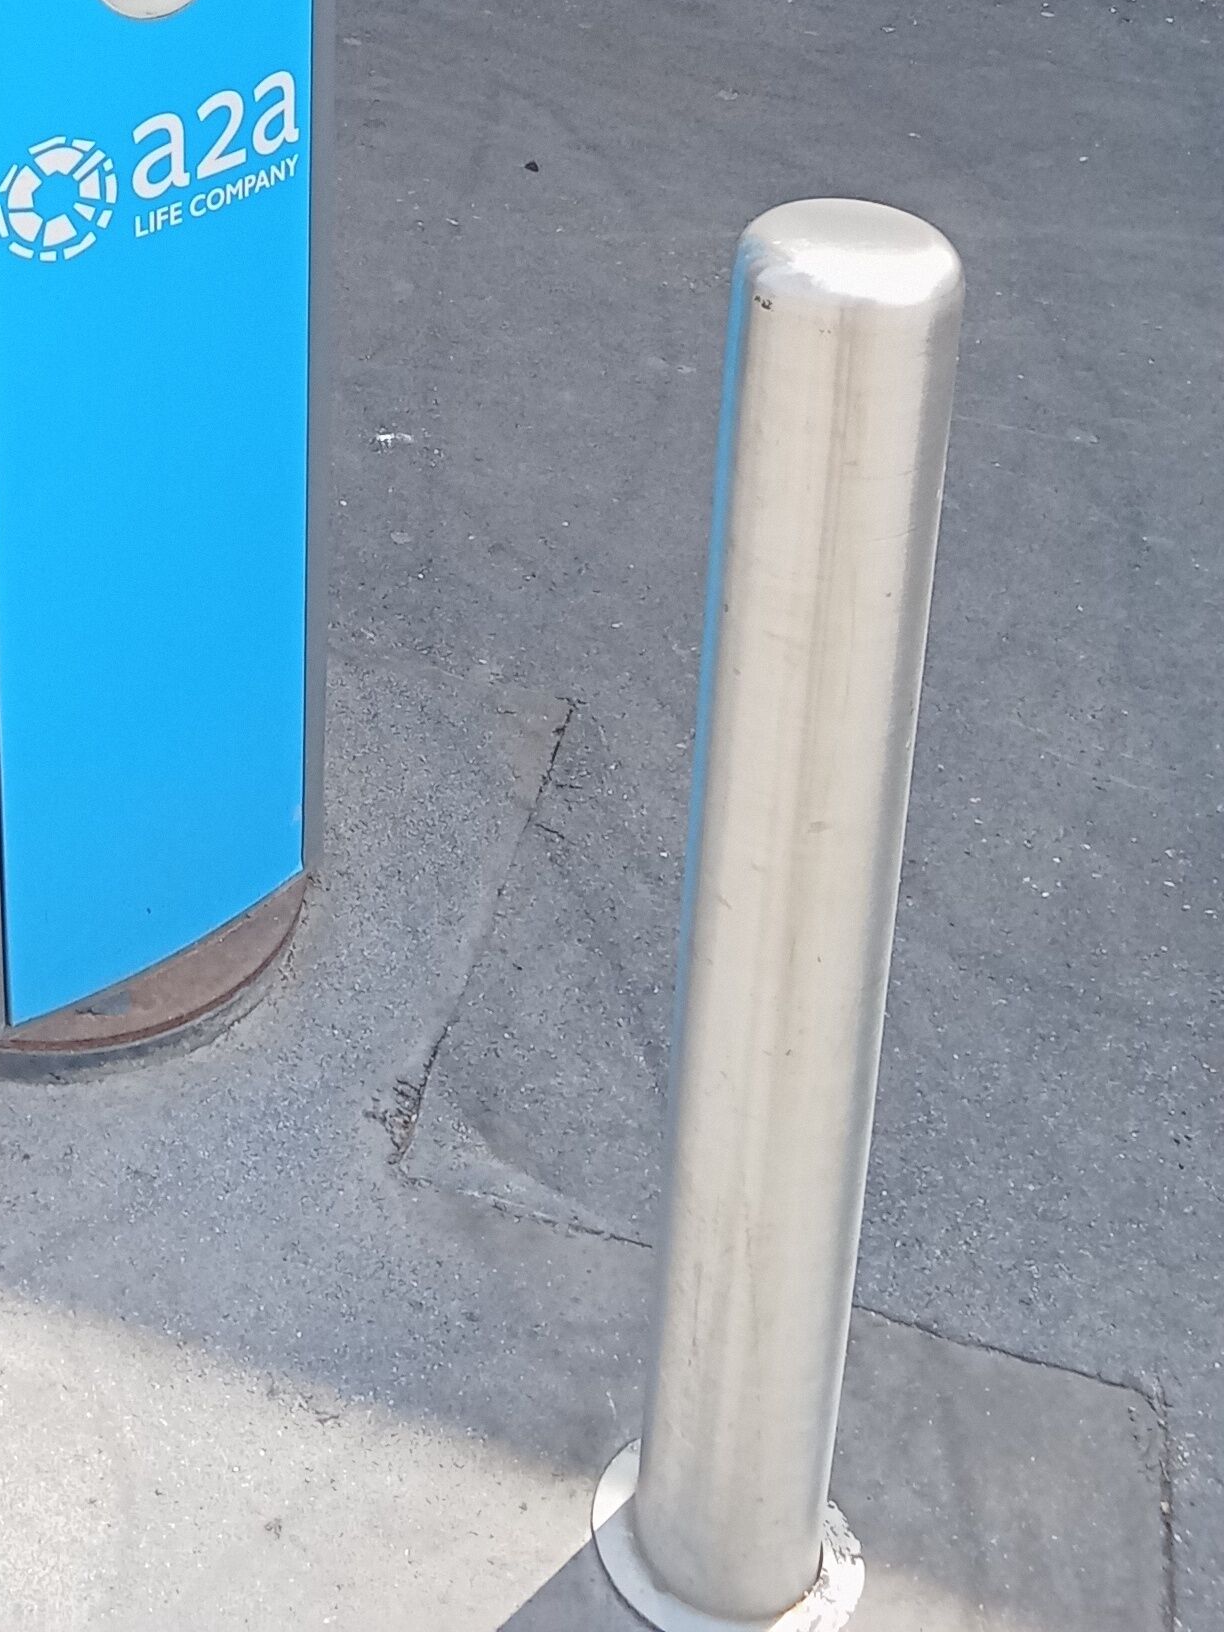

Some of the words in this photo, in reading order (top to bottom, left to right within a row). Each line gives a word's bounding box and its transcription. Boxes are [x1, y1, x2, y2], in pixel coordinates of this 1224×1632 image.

[132, 70, 300, 200] a2a
[134, 201, 183, 238] LIFE
[188, 153, 299, 218] COMPANY
